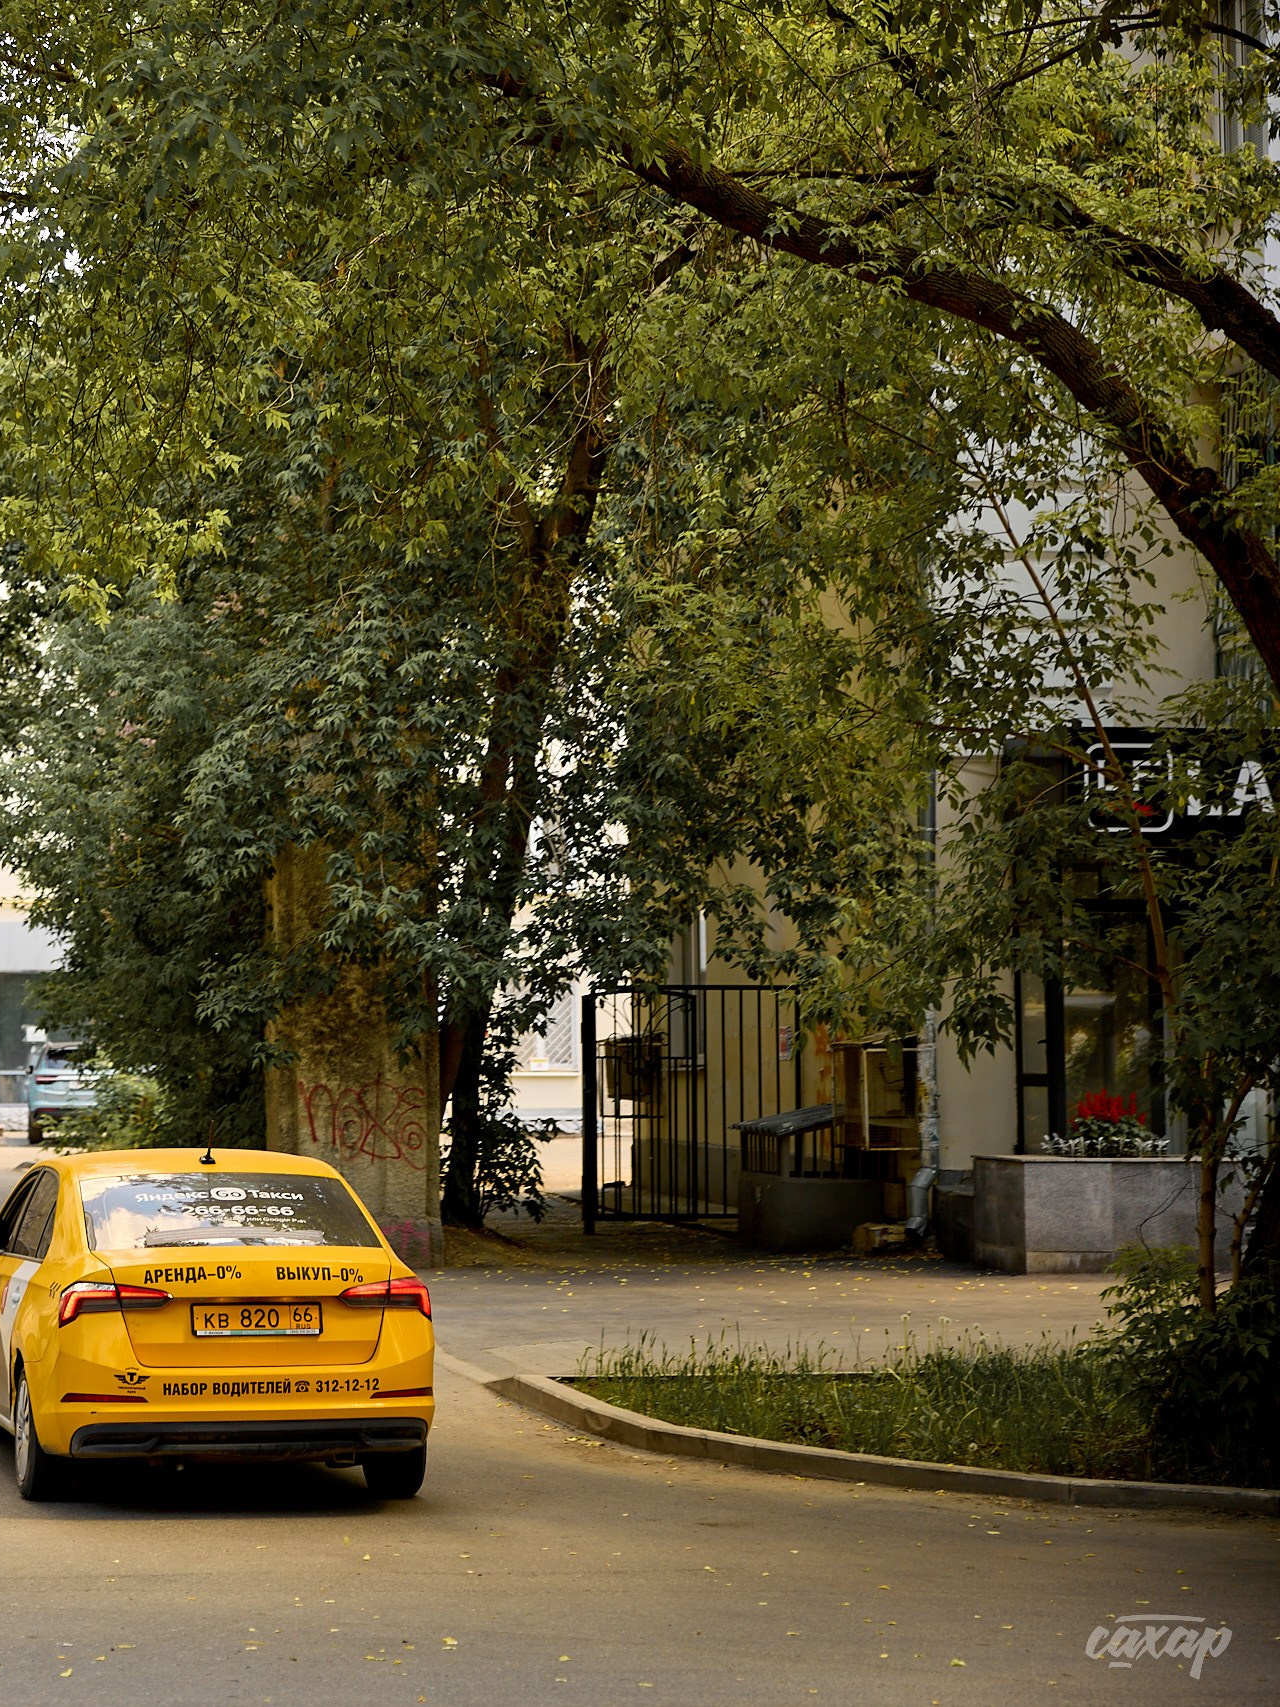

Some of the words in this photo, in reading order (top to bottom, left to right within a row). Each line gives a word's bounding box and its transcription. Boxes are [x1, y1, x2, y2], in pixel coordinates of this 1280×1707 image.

[135, 1192, 208, 1203] Яндекс
[247, 1189, 304, 1201] Такси
[182, 1205, 295, 1217] 266-66-66
[143, 1265, 242, 1284] АРЕНДА-0%
[276, 1266, 364, 1283] ВЫКУП-0%
[204, 1313, 229, 1328] КВ
[240, 1308, 280, 1328] 820
[293, 1307, 313, 1322] 66
[163, 1382, 208, 1396] НАБОР
[212, 1378, 291, 1397] ВОДИТЕЛЕЙ
[315, 1378, 380, 1393] 312-12-12
